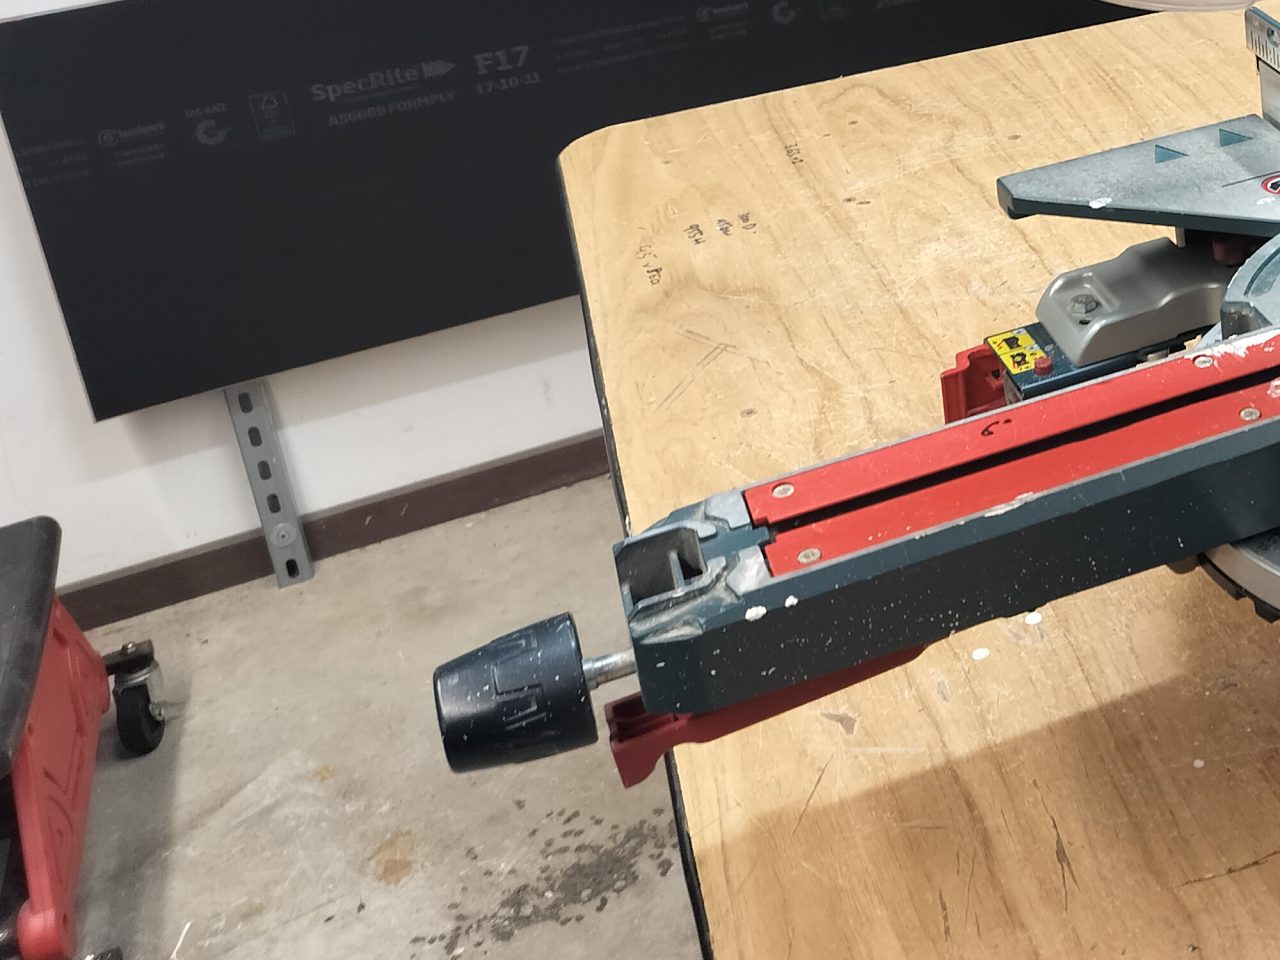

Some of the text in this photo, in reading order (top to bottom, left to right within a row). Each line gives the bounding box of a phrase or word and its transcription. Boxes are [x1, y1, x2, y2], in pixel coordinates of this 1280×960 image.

[474, 45, 529, 75] F17
[311, 67, 418, 102] SpecRite
[475, 71, 542, 95] 17-10-11
